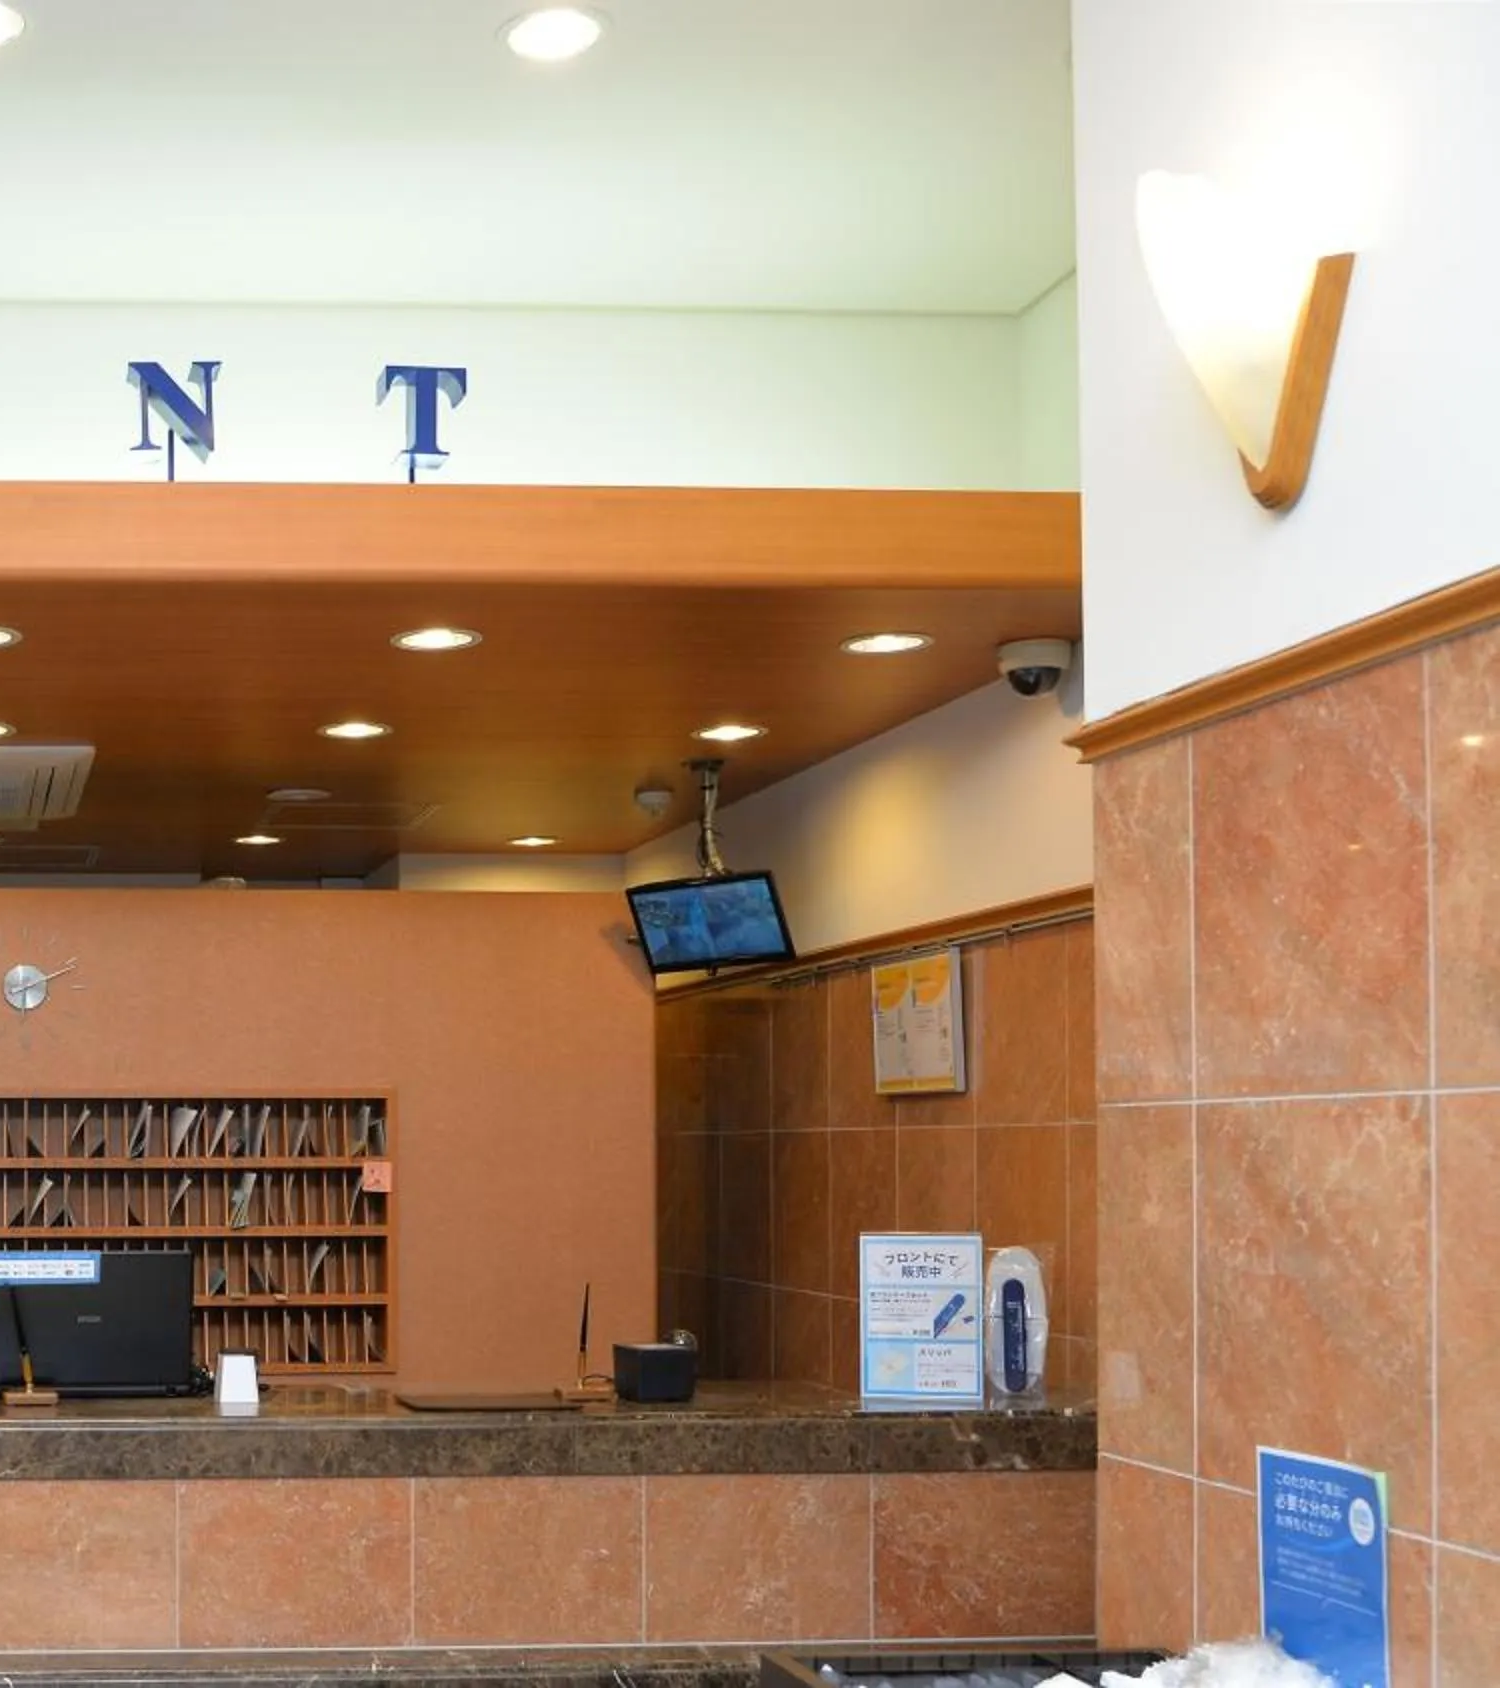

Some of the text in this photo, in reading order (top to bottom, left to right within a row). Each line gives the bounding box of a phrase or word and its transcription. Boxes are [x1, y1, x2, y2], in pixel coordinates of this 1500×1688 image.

[884, 1251, 960, 1266] フロントにて
[901, 1265, 942, 1279] 販売中
